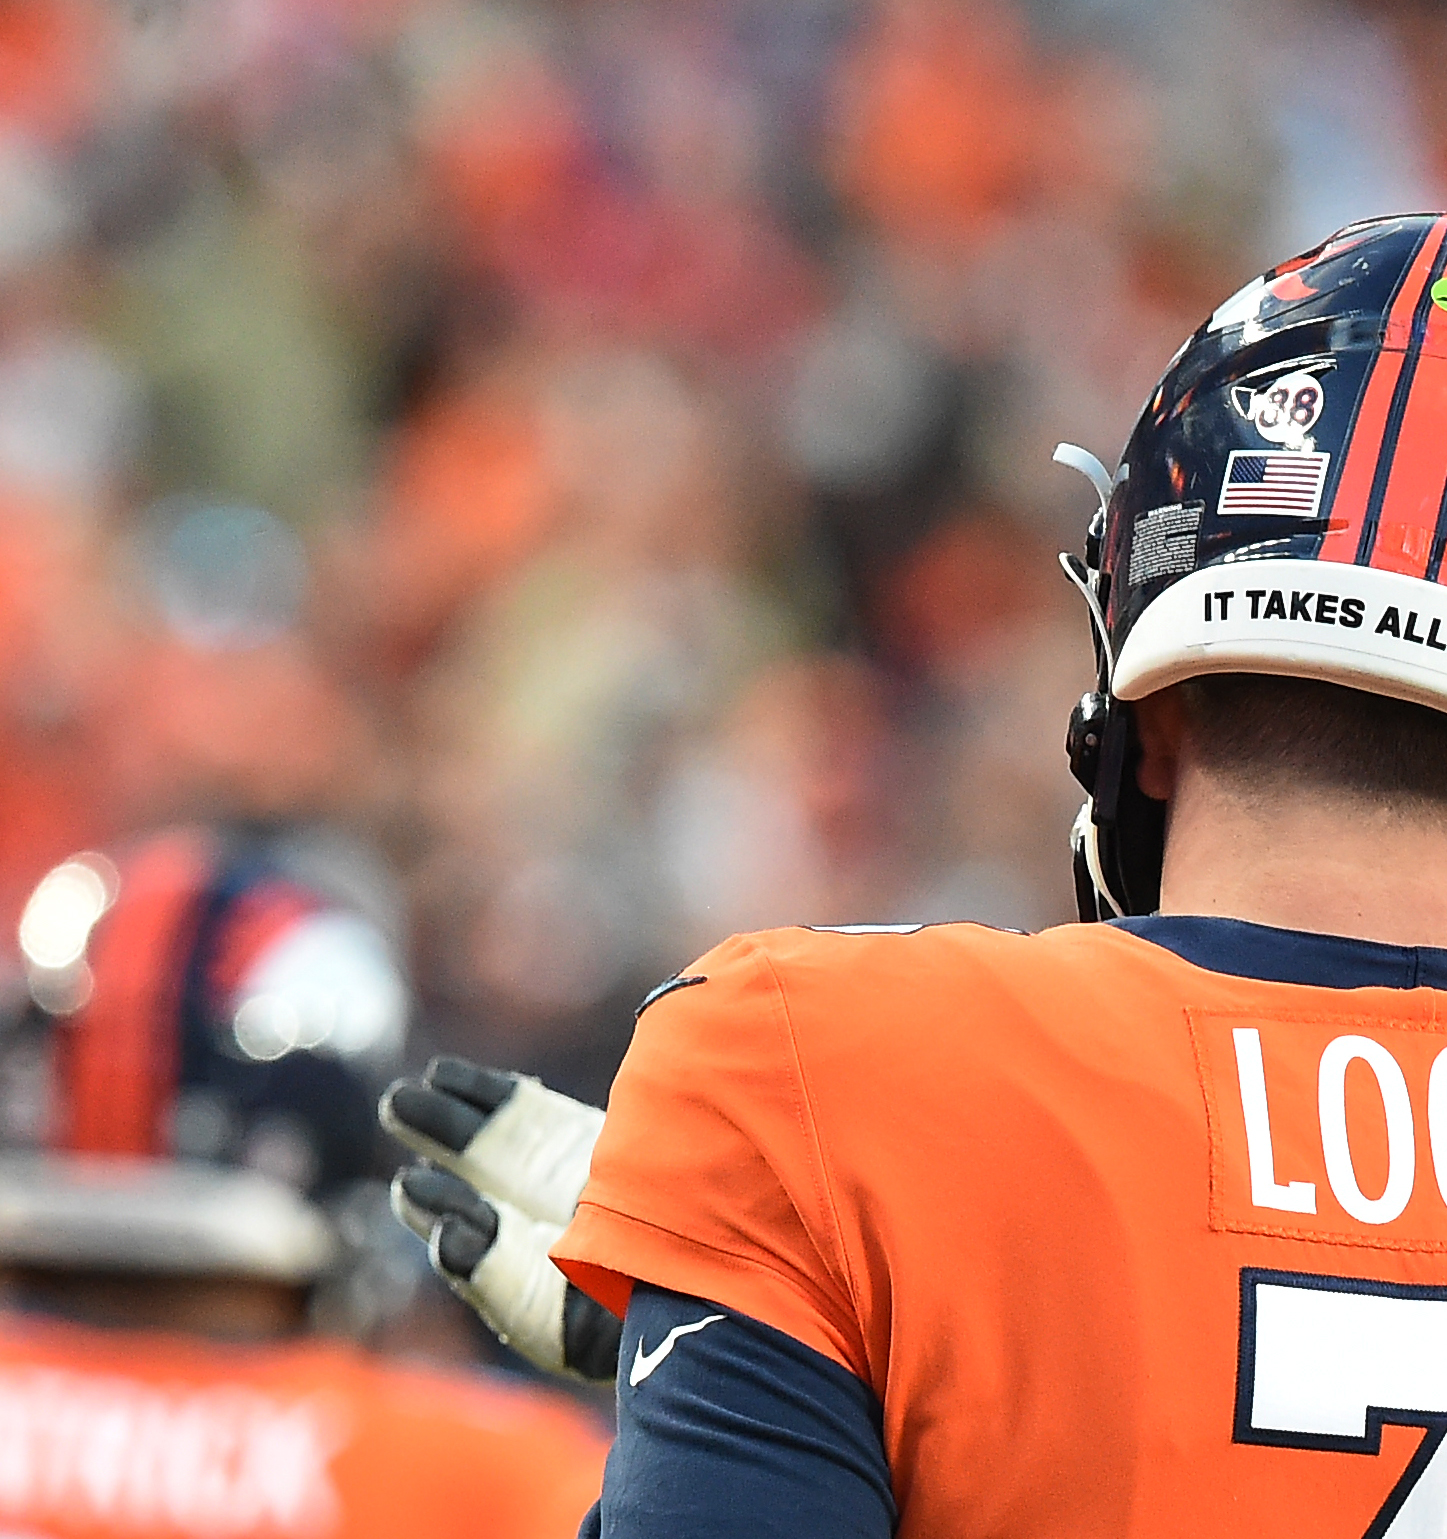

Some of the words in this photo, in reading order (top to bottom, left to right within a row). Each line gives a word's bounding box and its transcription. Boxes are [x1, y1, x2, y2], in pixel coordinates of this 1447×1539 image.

[1204, 590, 1235, 622] IT
[1245, 589, 1366, 629] TAKES
[1374, 606, 1447, 651] ALL
